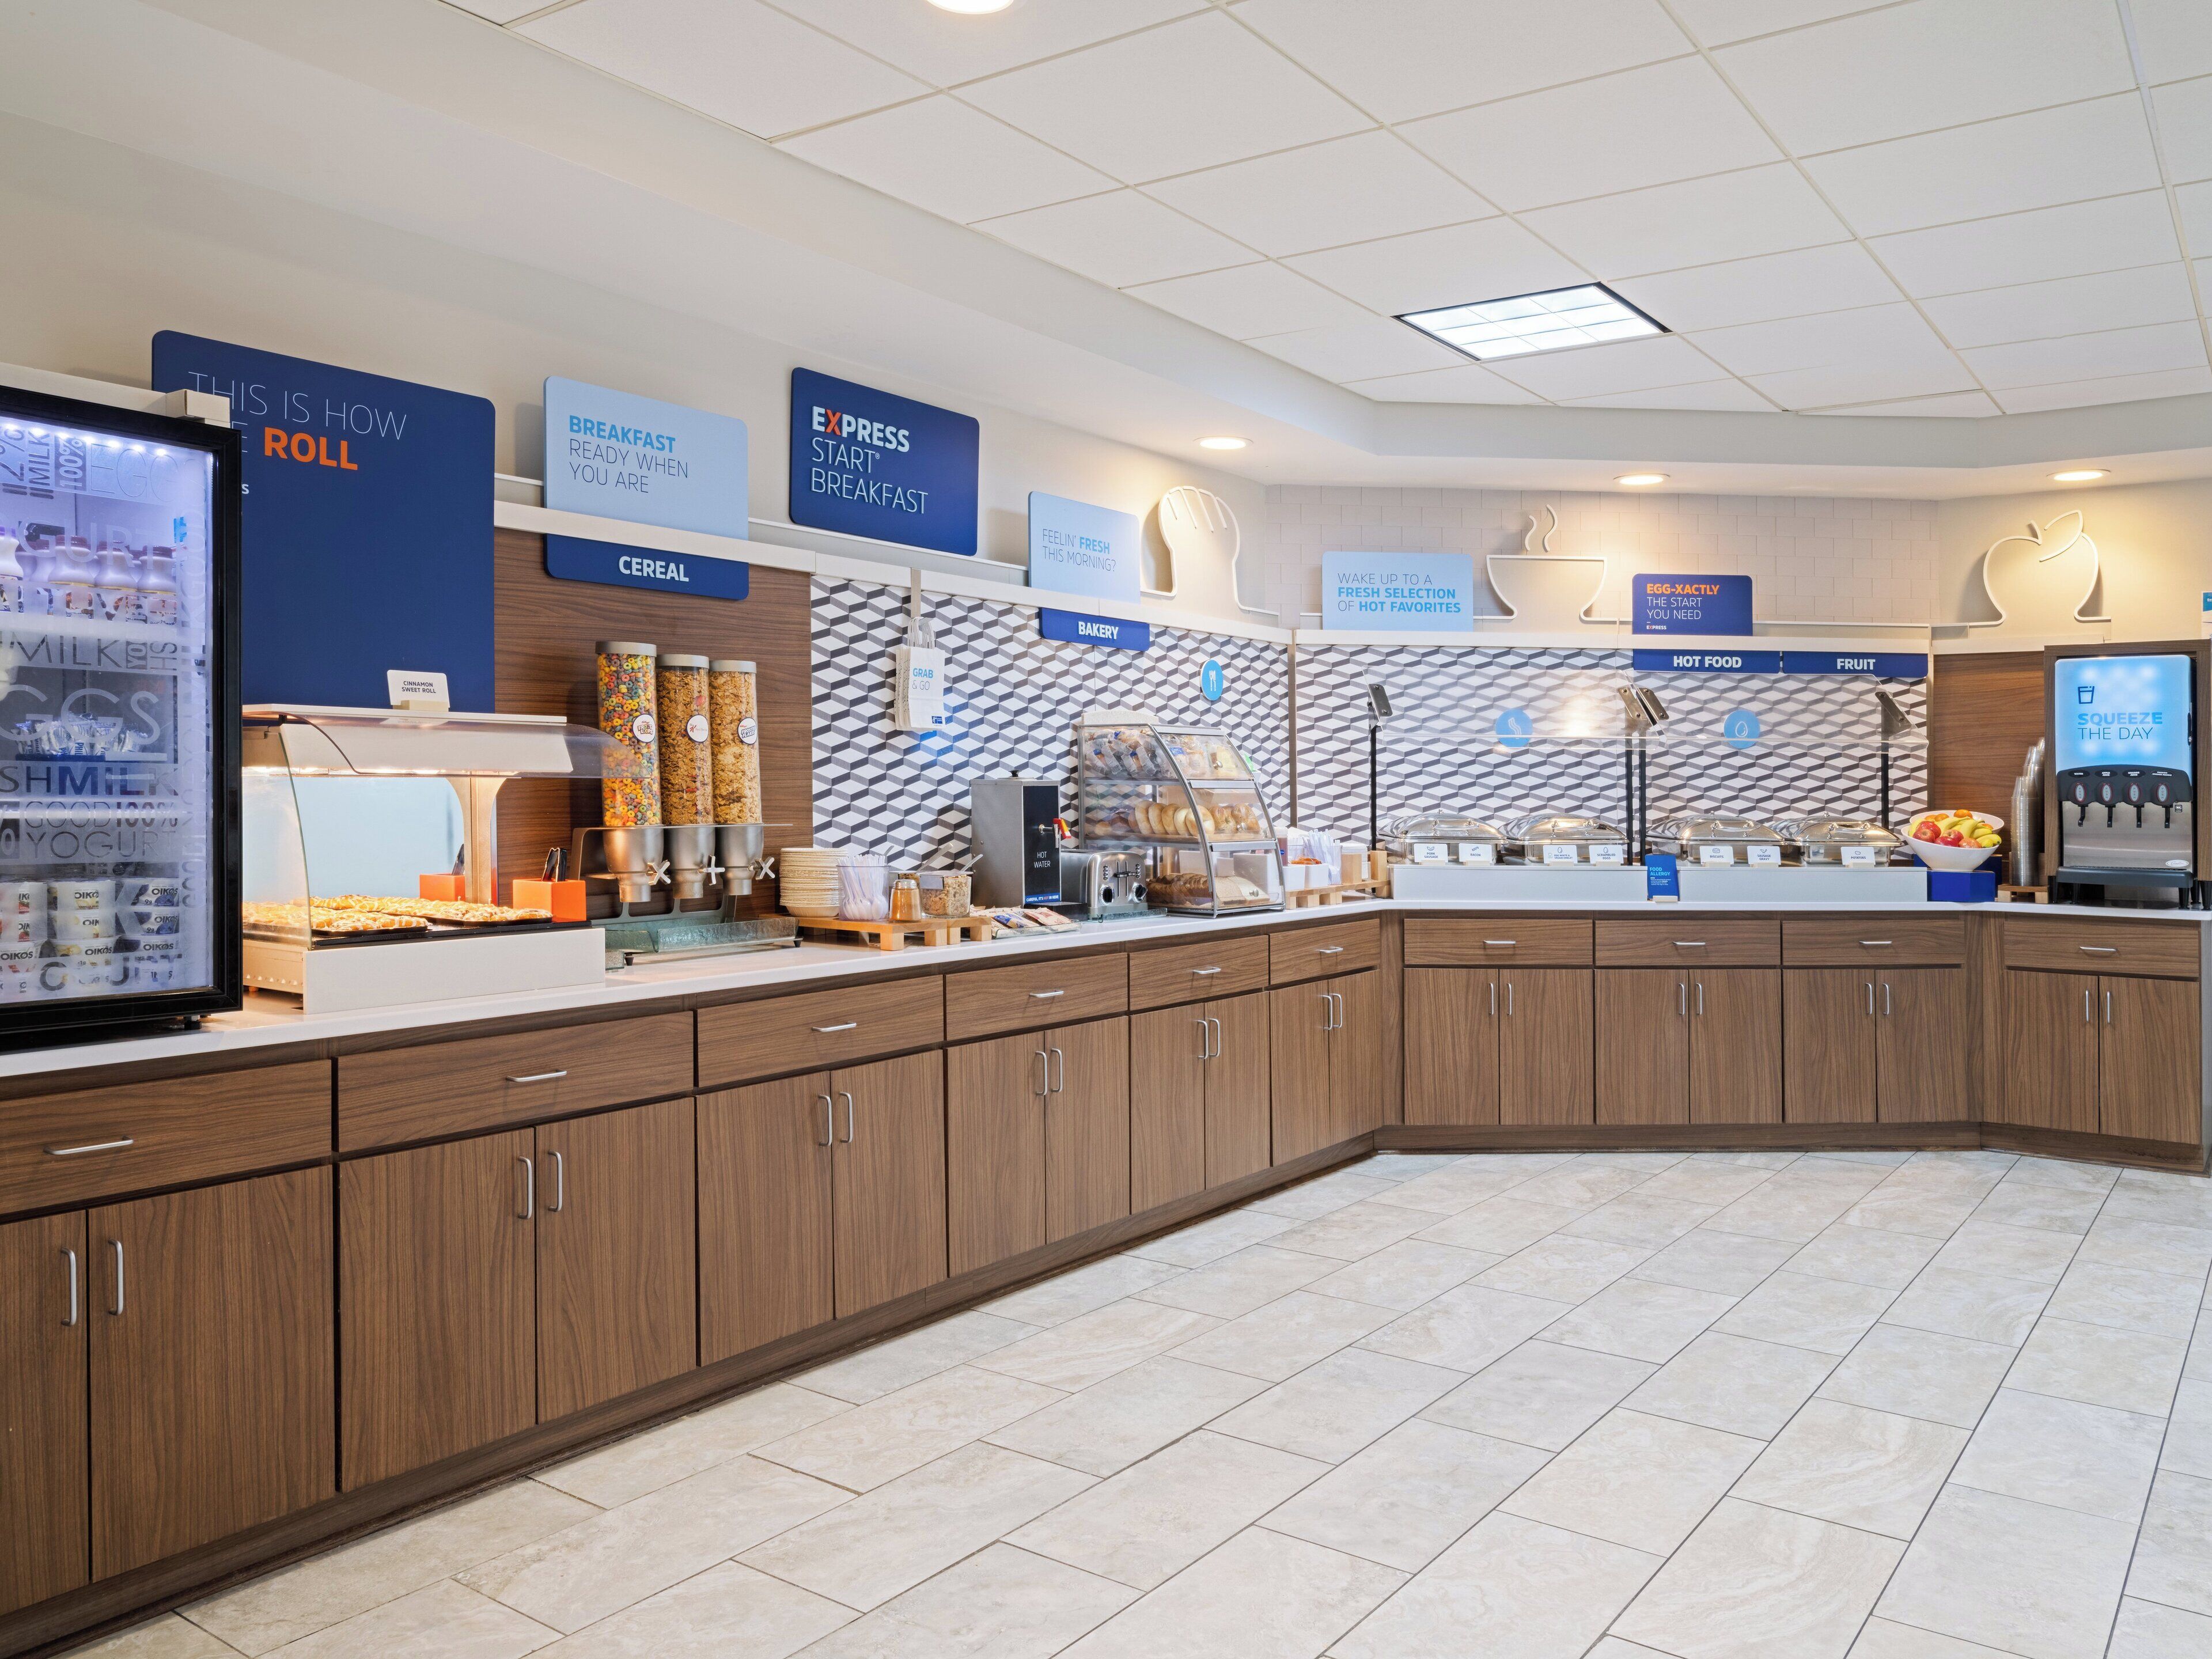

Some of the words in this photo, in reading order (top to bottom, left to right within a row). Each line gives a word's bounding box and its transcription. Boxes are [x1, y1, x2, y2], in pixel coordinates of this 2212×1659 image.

[188, 372, 267, 415] THIS
[285, 391, 309, 422] IS
[326, 399, 407, 440] HOW
[569, 415, 676, 453] BREAKFAST
[812, 406, 910, 453] EXPRESS
[28, 430, 51, 486] MILK
[264, 427, 358, 471] ROLL
[570, 438, 630, 467] READY
[636, 452, 688, 478] WHEN
[569, 462, 608, 485] YOU
[615, 471, 649, 493] ARE
[810, 467, 929, 514] BREAKFAST
[1079, 536, 1110, 555] FRESH
[618, 555, 690, 582] CEREAL
[1042, 546, 1064, 563] THIS
[1067, 551, 1116, 572] MORNING?
[1337, 573, 1376, 584] WAKE
[1380, 574, 1398, 585] UP
[1402, 574, 1419, 585] TO
[1423, 574, 1433, 585] A
[1646, 584, 1720, 595] EGG-XACTLY
[1338, 586, 1380, 598] FRESH
[1384, 587, 1456, 599] SELECTION
[1646, 597, 1667, 607] THE
[1671, 597, 1703, 608] START
[1338, 600, 1355, 612] OF
[1358, 601, 1386, 612] HOT
[1390, 601, 1461, 613] FAVORITES
[1646, 609, 1669, 620] YOU
[1673, 609, 1702, 620] NEED
[1078, 620, 1119, 640] BAKERY
[9, 631, 123, 668] MILK
[912, 668, 934, 679] GRAB
[1673, 656, 1702, 668] HOT
[1705, 656, 1742, 668] FOOD
[1836, 658, 1876, 671] FRUIT
[912, 680, 918, 690] &
[919, 680, 930, 691] GO
[2077, 712, 2163, 726] SQUEEZE
[2077, 728, 2111, 740] THE
[2119, 727, 2153, 740] DAY
[58, 766, 179, 796] MILK
[24, 801, 112, 828] GOOD
[116, 801, 179, 828] 100%
[26, 830, 177, 859] YOGURT
